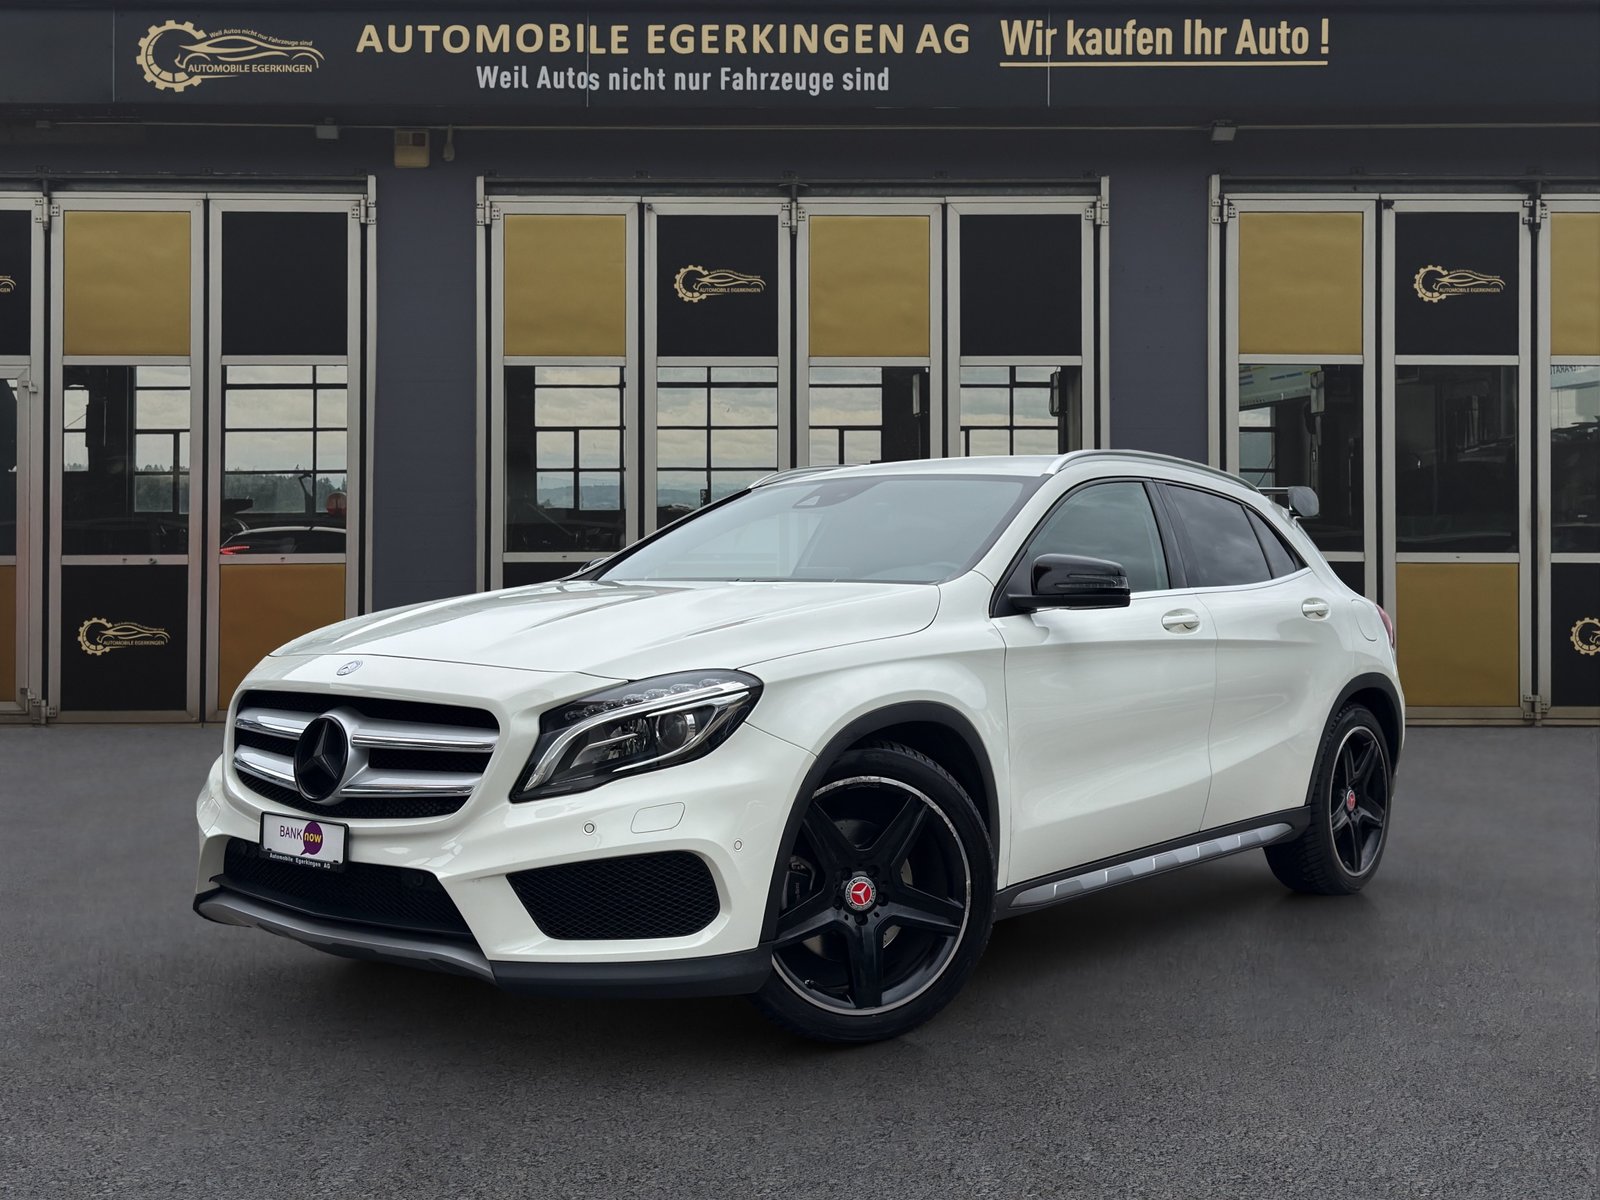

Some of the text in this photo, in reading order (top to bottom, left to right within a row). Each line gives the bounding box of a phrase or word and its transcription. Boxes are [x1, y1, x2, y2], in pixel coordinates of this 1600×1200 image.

[208, 29, 223, 38] Weil
[242, 29, 258, 37] nicht
[269, 36, 299, 46] Fahrzeuge
[355, 23, 970, 54] AUTOMOBILE EGERKINGEN AG
[1000, 18, 1330, 56] Wir kaufen Ihr Auto !
[187, 64, 313, 73] AUTOMOBILE EGERKINGEN
[476, 65, 890, 96] Weil Autos nicht nur Fahrzeuge sind
[280, 825, 321, 843] BANK now
[269, 853, 293, 862] Automobile
[295, 858, 321, 867] Egerkingen
